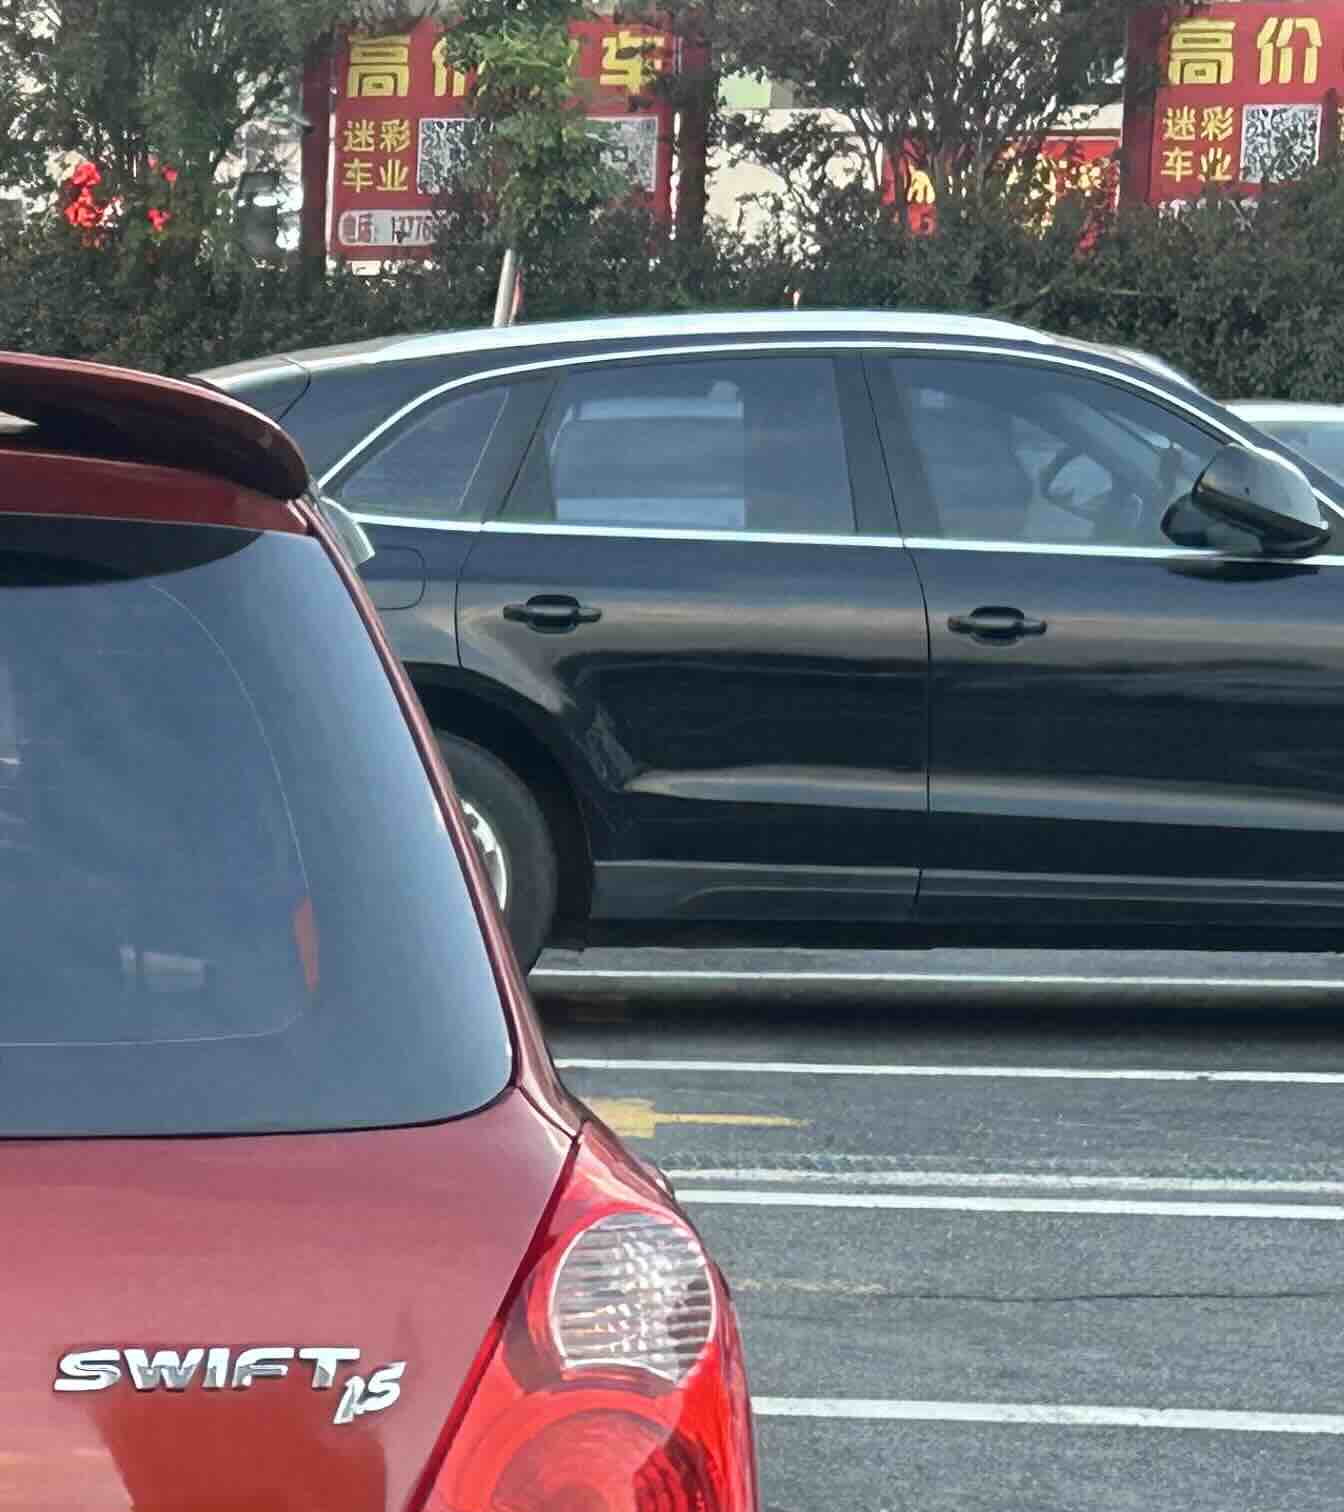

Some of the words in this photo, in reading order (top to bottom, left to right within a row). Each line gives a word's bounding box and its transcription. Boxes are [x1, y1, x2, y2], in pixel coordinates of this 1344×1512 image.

[343, 119, 410, 153] 迷彩
[1163, 105, 1234, 142] 迷彩
[342, 159, 409, 193] 车业
[53, 1347, 360, 1391] SWIFT
